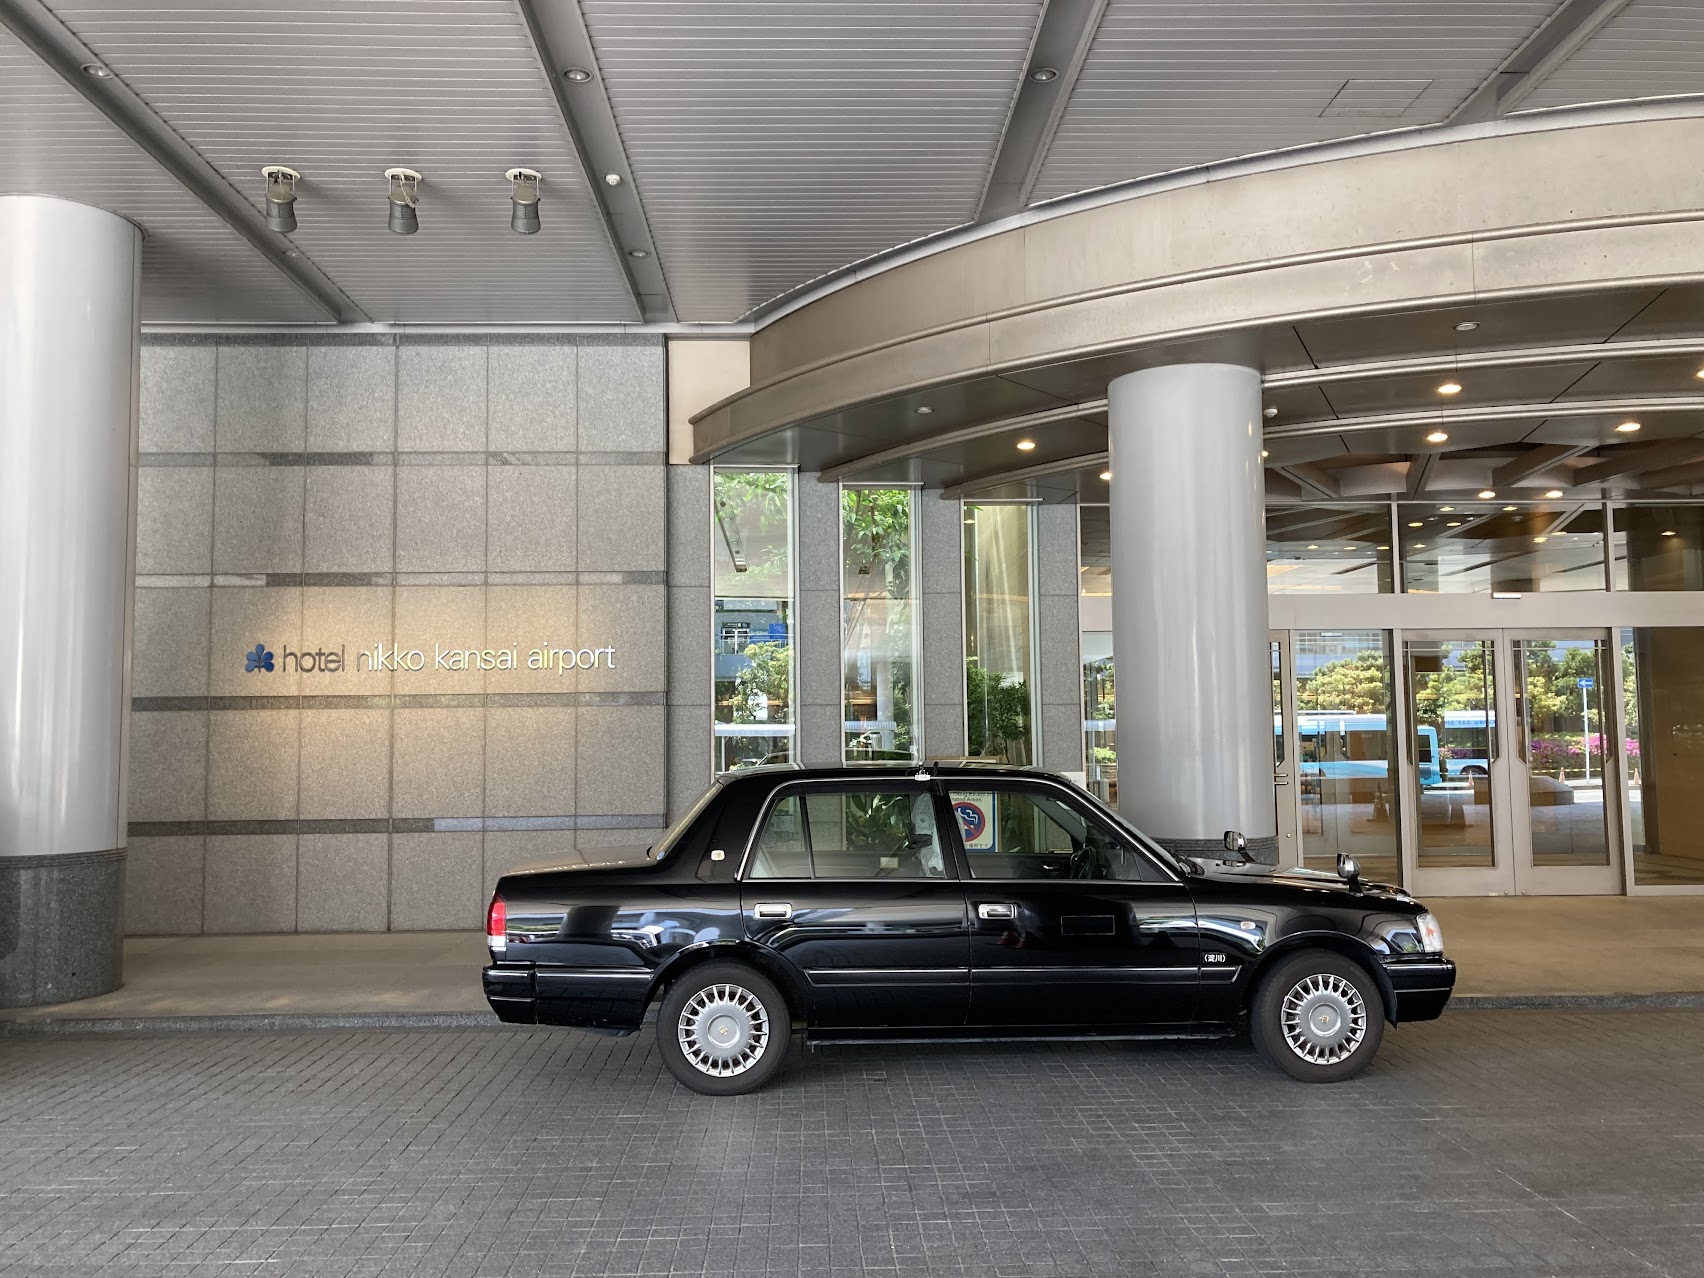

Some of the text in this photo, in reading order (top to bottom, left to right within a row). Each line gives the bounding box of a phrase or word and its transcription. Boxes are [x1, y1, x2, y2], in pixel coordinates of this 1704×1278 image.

[283, 641, 616, 676] hotel nikko kansai airport
